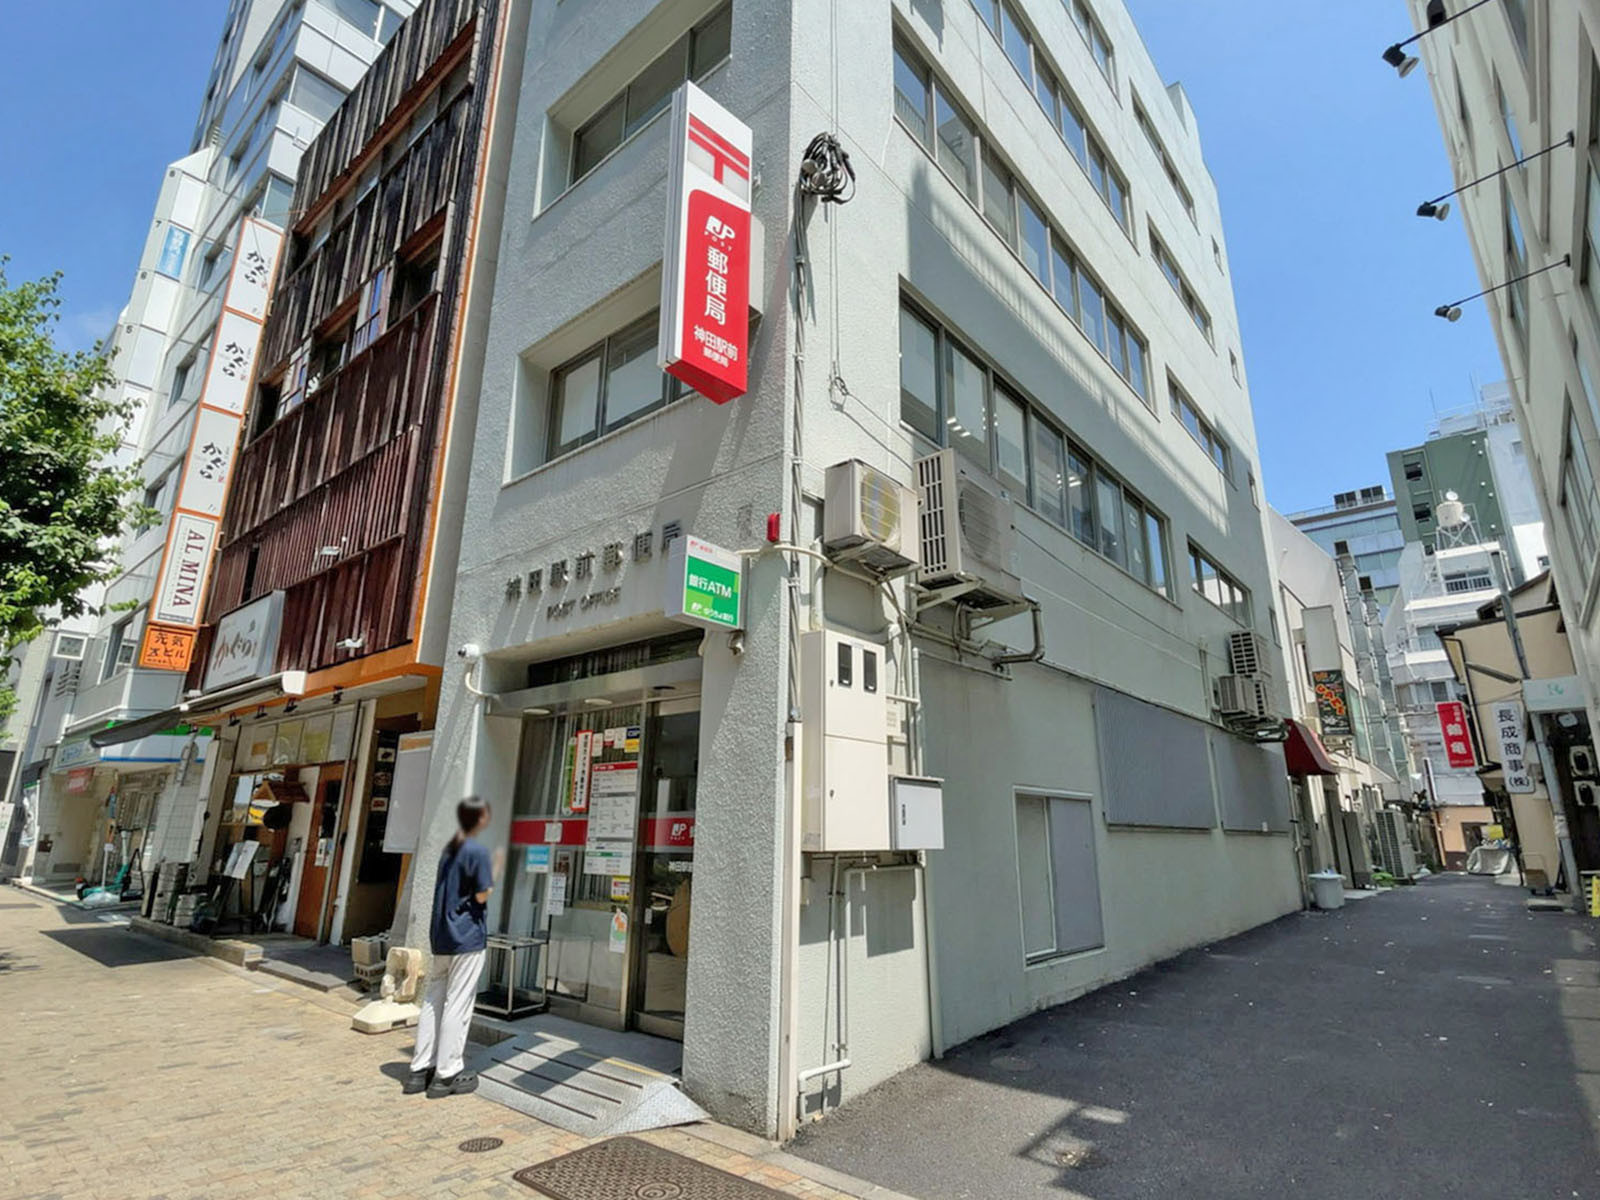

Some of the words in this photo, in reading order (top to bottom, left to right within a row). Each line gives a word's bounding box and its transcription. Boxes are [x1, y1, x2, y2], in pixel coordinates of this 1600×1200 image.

[704, 246, 729, 326] 郵便局
[694, 325, 739, 362] 神田駅前
[184, 529, 206, 554] AL
[172, 558, 201, 607] MINA
[688, 573, 733, 599] 銀行ATM
[547, 599, 577, 621] POST
[580, 585, 621, 611] OFFICE
[154, 632, 185, 647] 元気
